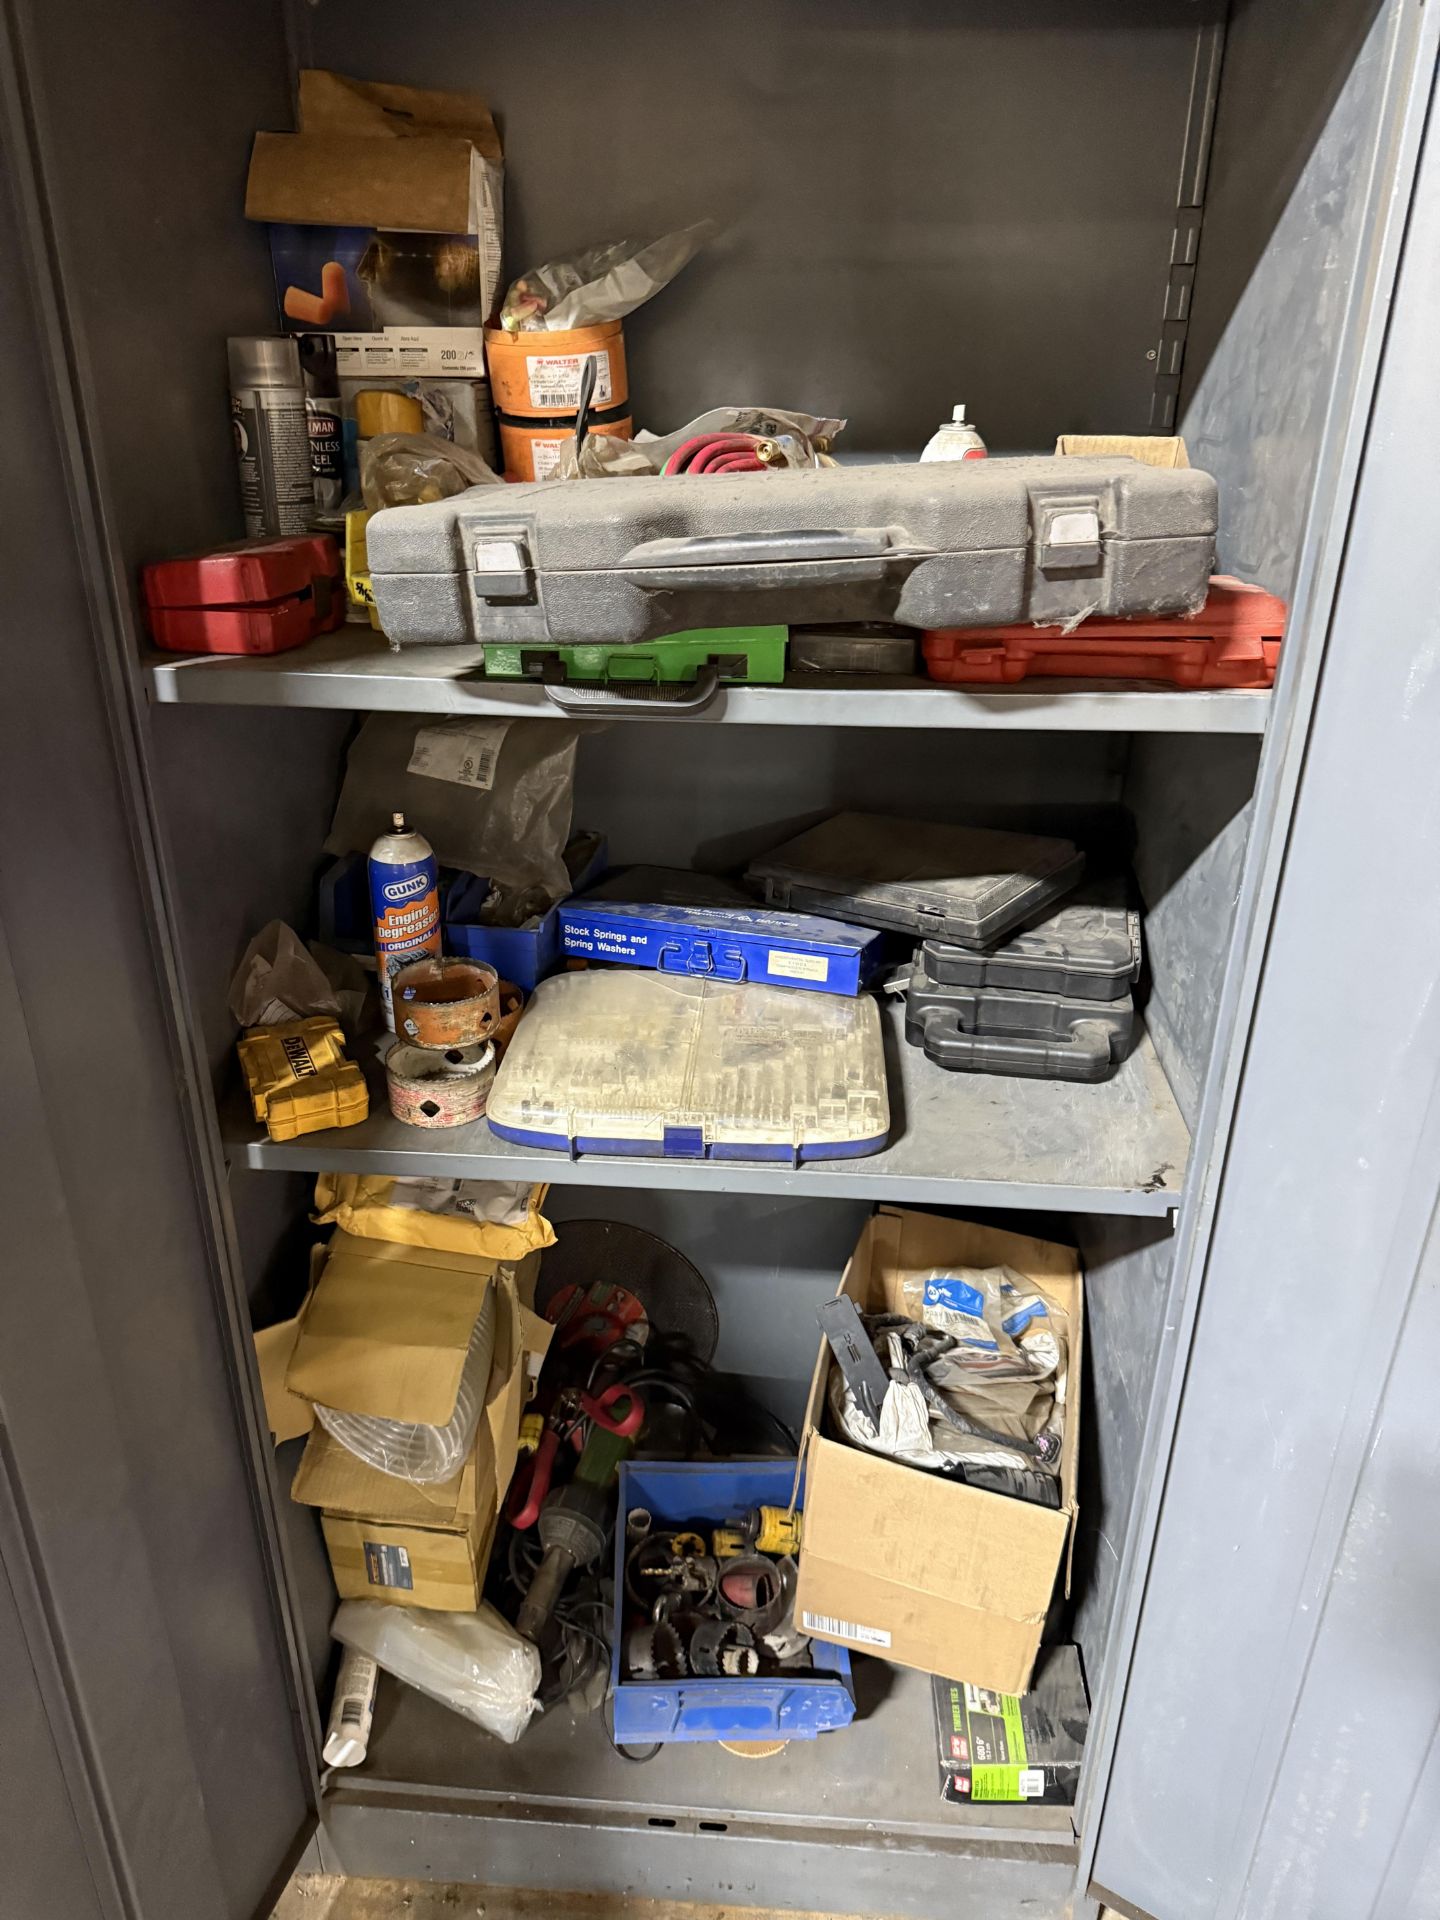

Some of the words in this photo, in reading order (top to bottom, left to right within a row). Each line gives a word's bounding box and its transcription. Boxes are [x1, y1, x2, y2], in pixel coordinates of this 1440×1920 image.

[441, 350, 457, 360] 200
[545, 358, 579, 366] WALTER
[310, 441, 341, 452] NLESS
[314, 454, 332, 465] EEL
[387, 877, 426, 897] GUNK
[378, 908, 438, 939] Degreaser
[388, 905, 429, 926] Engine
[387, 929, 434, 950] ORIGINAL
[564, 924, 590, 936] Stock
[593, 928, 627, 942] Springs
[630, 935, 648, 945] and
[564, 937, 594, 951] Spring
[597, 942, 636, 956] Washers
[950, 1687, 960, 1703] TIES
[952, 1704, 962, 1732] TIMBER
